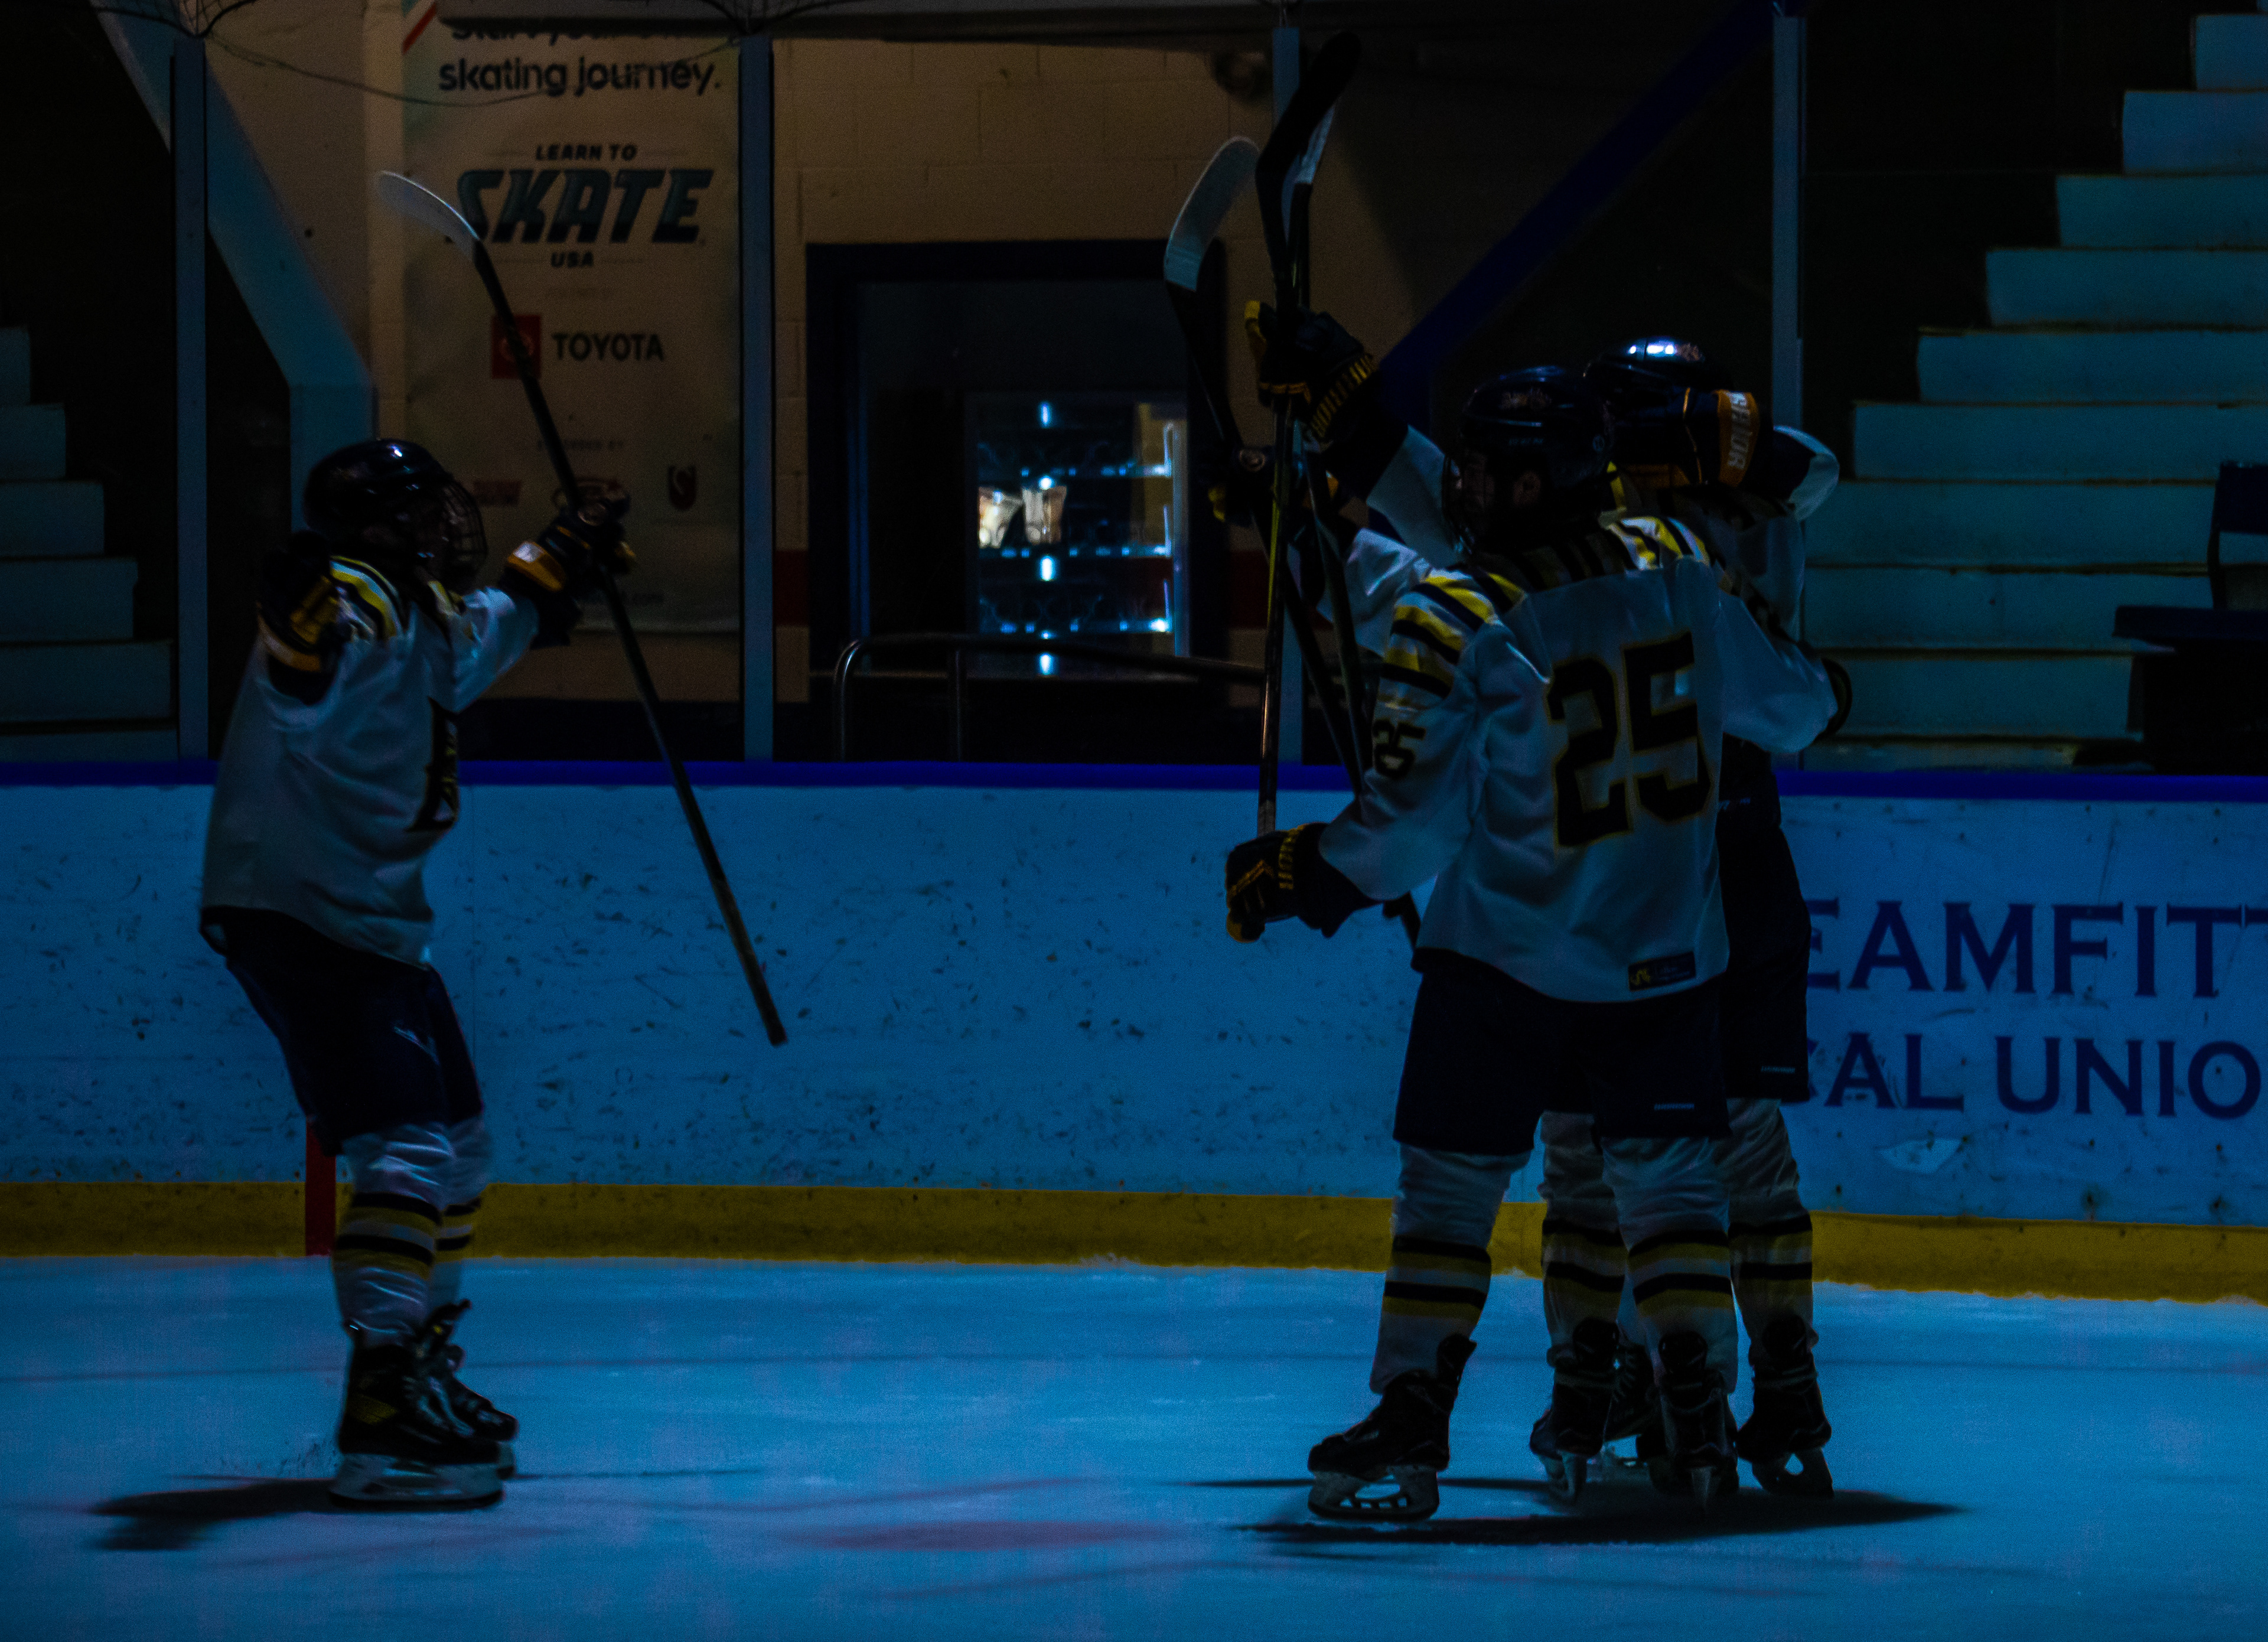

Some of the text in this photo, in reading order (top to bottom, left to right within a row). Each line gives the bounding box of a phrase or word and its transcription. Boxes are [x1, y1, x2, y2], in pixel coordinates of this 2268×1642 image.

[439, 55, 721, 96] skating journey.
[536, 144, 638, 161] LEARN TO
[445, 169, 714, 243] SKATE
[550, 251, 594, 268] USA
[551, 333, 664, 361] TOYOTA
[1546, 627, 1712, 848] 25
[1807, 1032, 1965, 1112] AL
